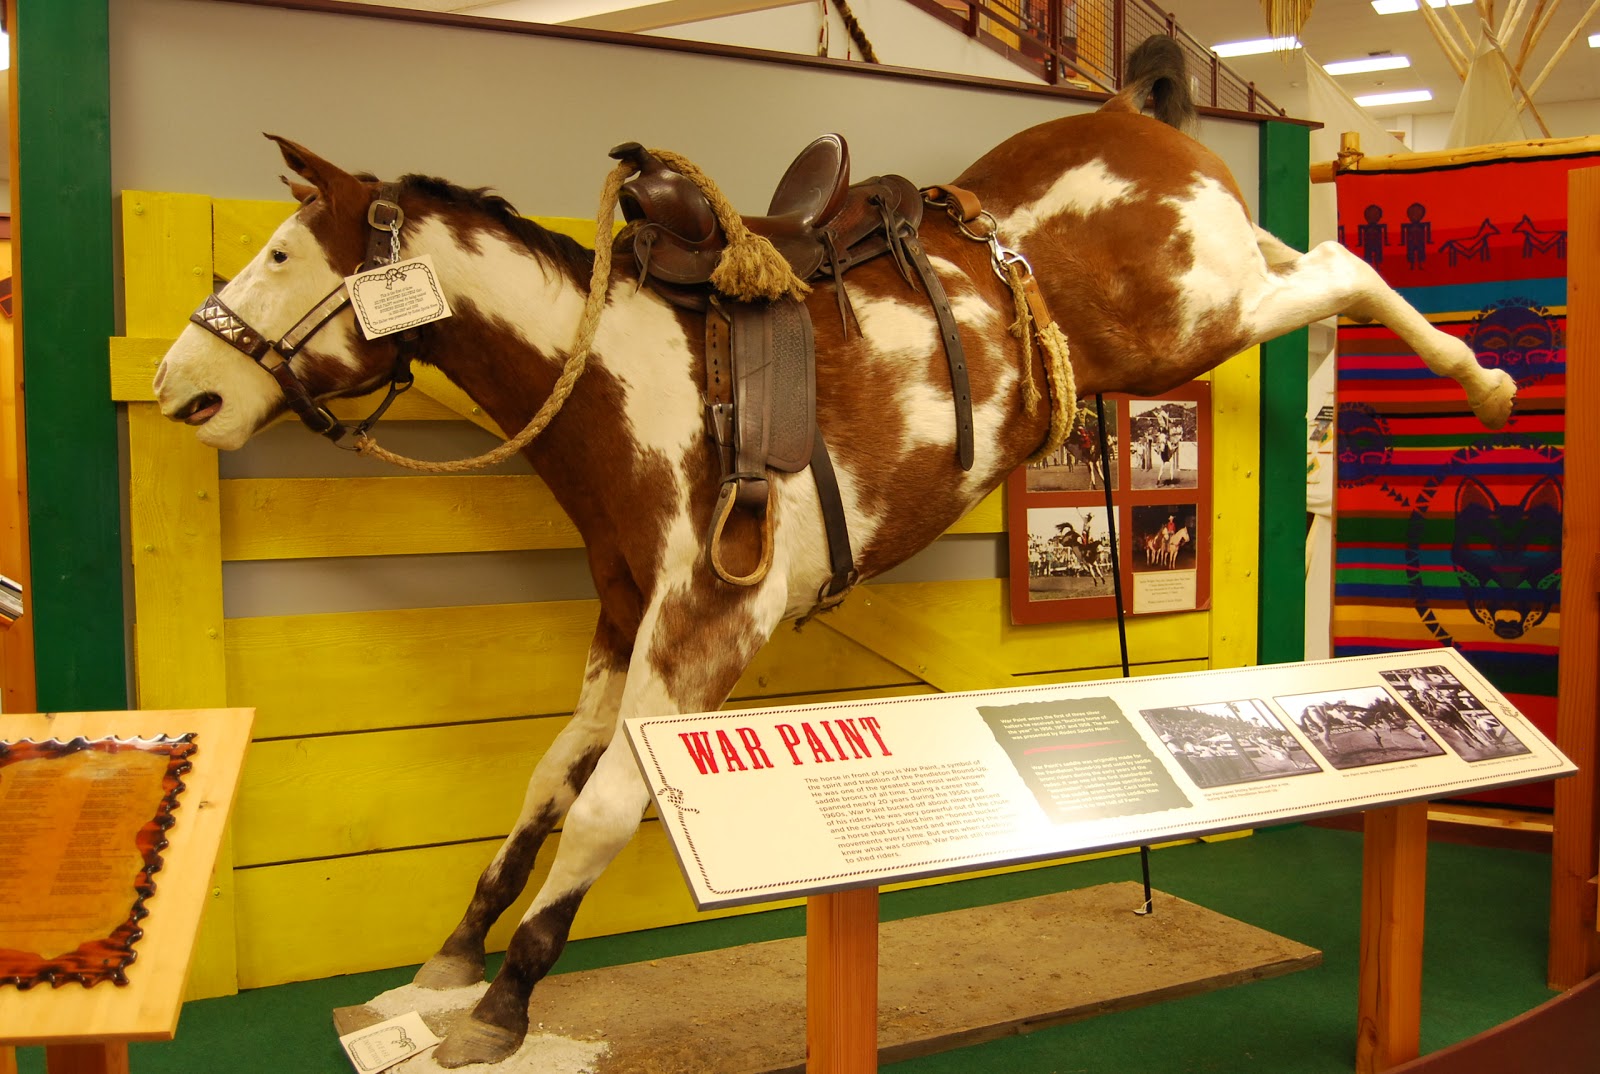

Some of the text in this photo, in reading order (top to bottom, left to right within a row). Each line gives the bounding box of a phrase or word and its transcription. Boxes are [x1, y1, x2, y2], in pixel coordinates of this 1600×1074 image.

[678, 717, 892, 774] WAR PAINT
[880, 782, 910, 790] greatest
[946, 774, 985, 782] well-known
[974, 793, 1001, 801] percent
[819, 804, 852, 812] spanned
[921, 806, 953, 815] powerful
[861, 822, 895, 830] cowboys
[838, 839, 883, 848] movements
[902, 840, 932, 848] coming,
